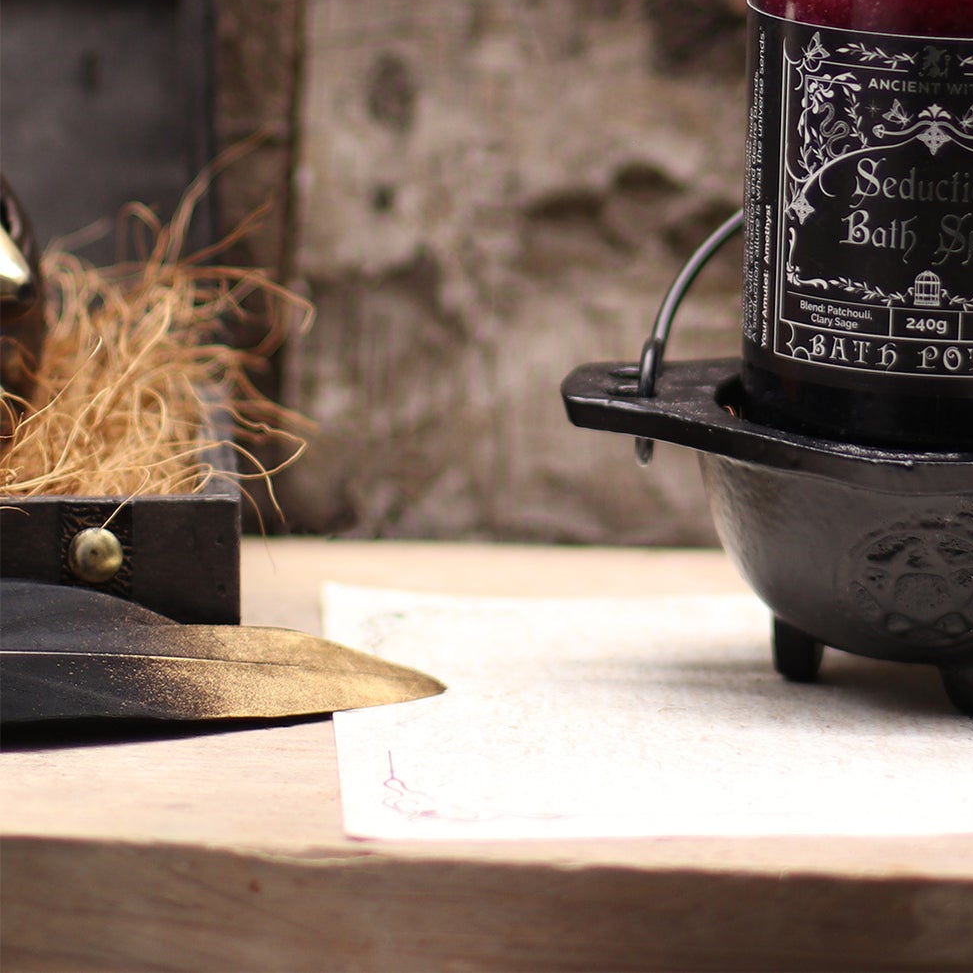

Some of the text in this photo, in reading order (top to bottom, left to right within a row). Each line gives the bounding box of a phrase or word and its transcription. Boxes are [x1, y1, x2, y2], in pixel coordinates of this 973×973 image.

[868, 77, 941, 94] ANCIENT
[764, 204, 772, 265] Amethyst
[839, 209, 918, 264] Bath
[800, 299, 873, 321] Blend: Patchouli,
[810, 313, 858, 330] Clary Sage
[905, 316, 948, 335] 240g
